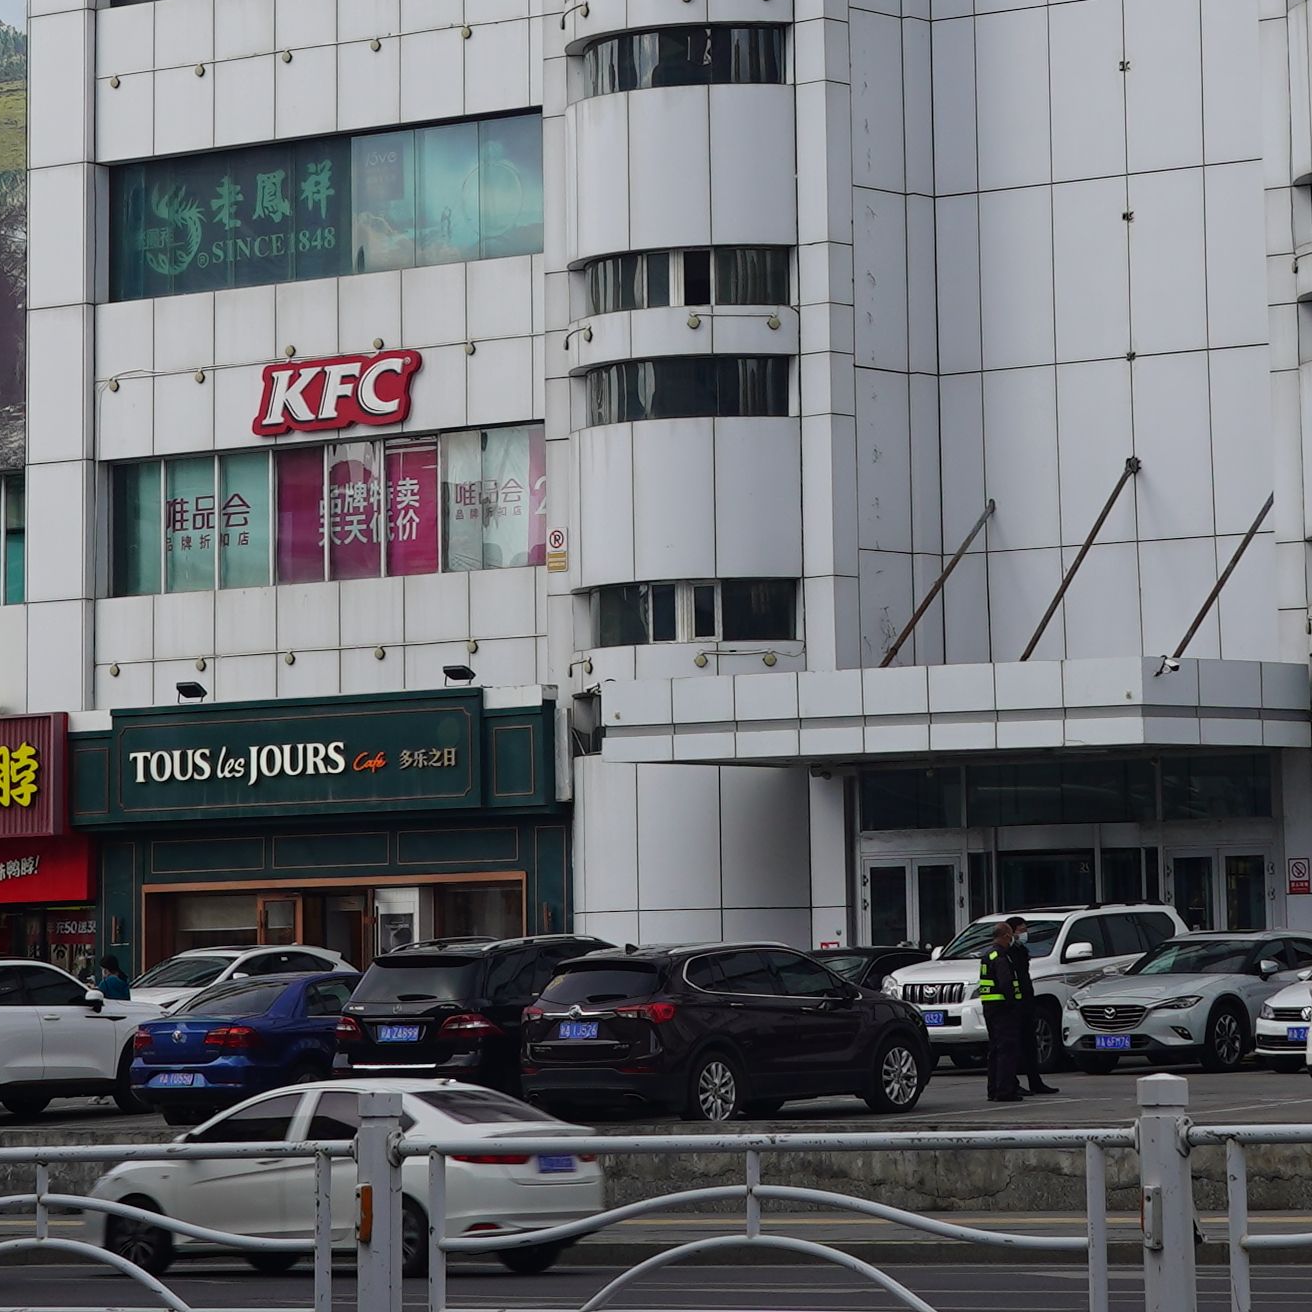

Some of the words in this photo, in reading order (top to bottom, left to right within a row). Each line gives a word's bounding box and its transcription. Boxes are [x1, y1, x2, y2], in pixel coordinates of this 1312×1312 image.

[262, 358, 405, 426] KFC
[319, 477, 421, 515] 品牌特卖
[455, 479, 525, 506] 唯品会
[166, 493, 252, 534] 唯品会
[319, 510, 421, 547] 天天低价
[129, 748, 212, 783] TOUS
[216, 745, 245, 779] les
[248, 741, 346, 785] JOURS
[399, 747, 457, 770] 多乐之日
